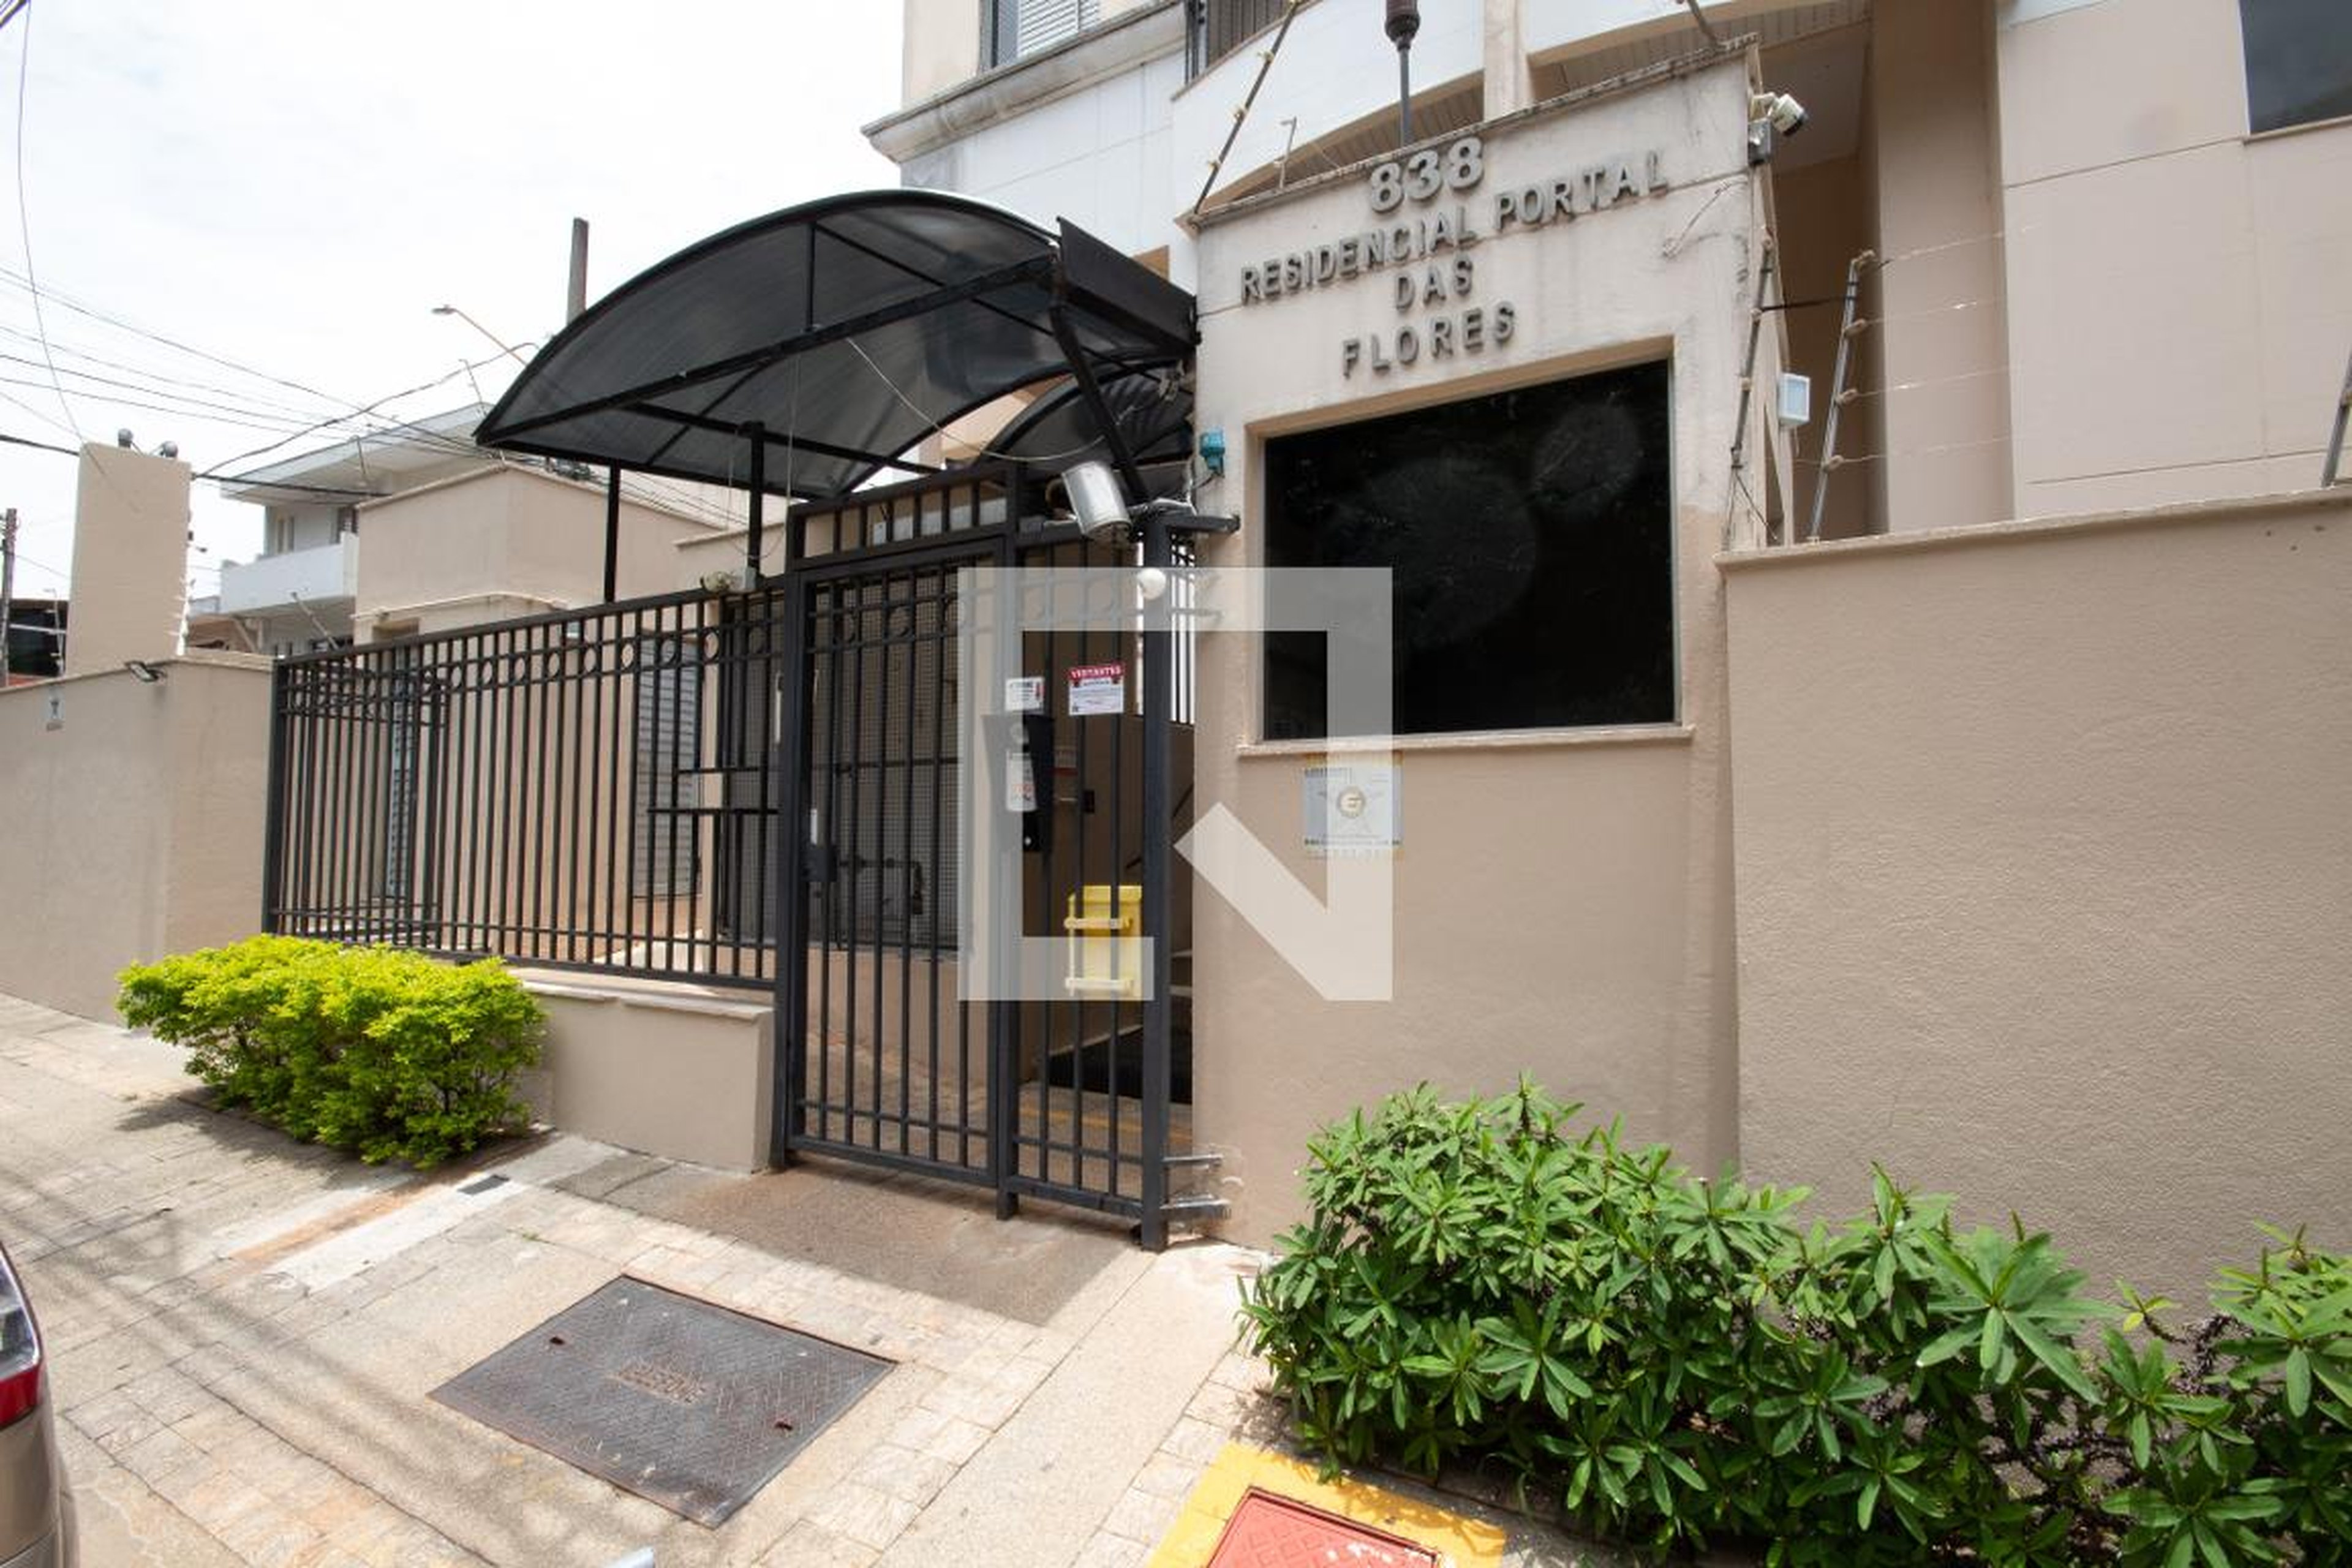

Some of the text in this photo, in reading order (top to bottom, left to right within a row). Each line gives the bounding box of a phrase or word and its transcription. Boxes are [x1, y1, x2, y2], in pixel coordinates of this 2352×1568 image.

[1370, 136, 1485, 214] 838
[1240, 149, 1670, 305] RESIDENCIAL PORTAL
[1395, 253, 1475, 314] DAS
[1342, 301, 1516, 379] FLORES
